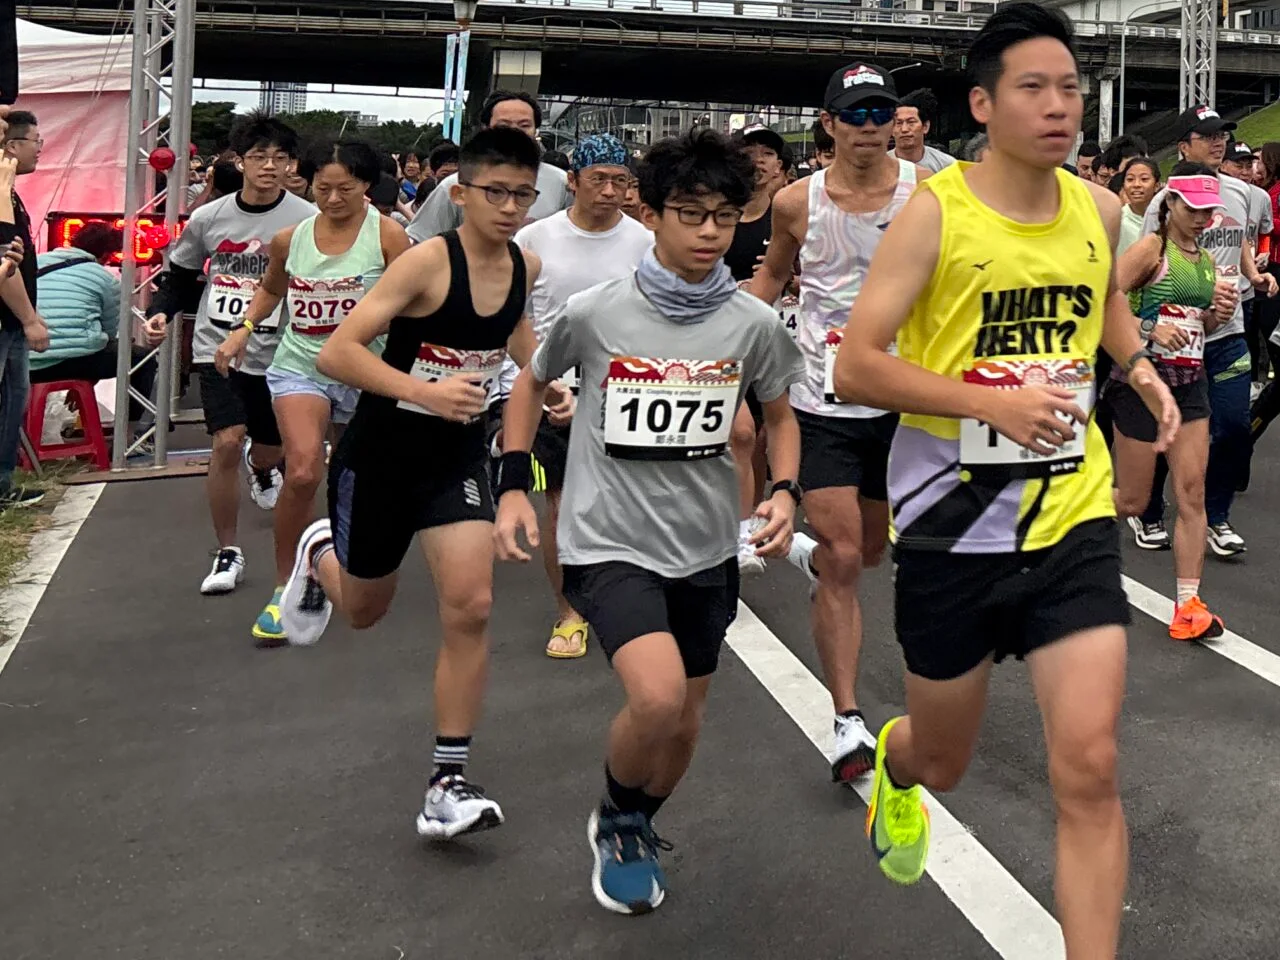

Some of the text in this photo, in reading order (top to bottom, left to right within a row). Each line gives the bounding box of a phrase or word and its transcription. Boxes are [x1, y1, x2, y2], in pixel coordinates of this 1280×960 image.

[293, 298, 358, 320] 2079
[982, 284, 1093, 324] WHAT'S
[620, 398, 725, 433] 1075
